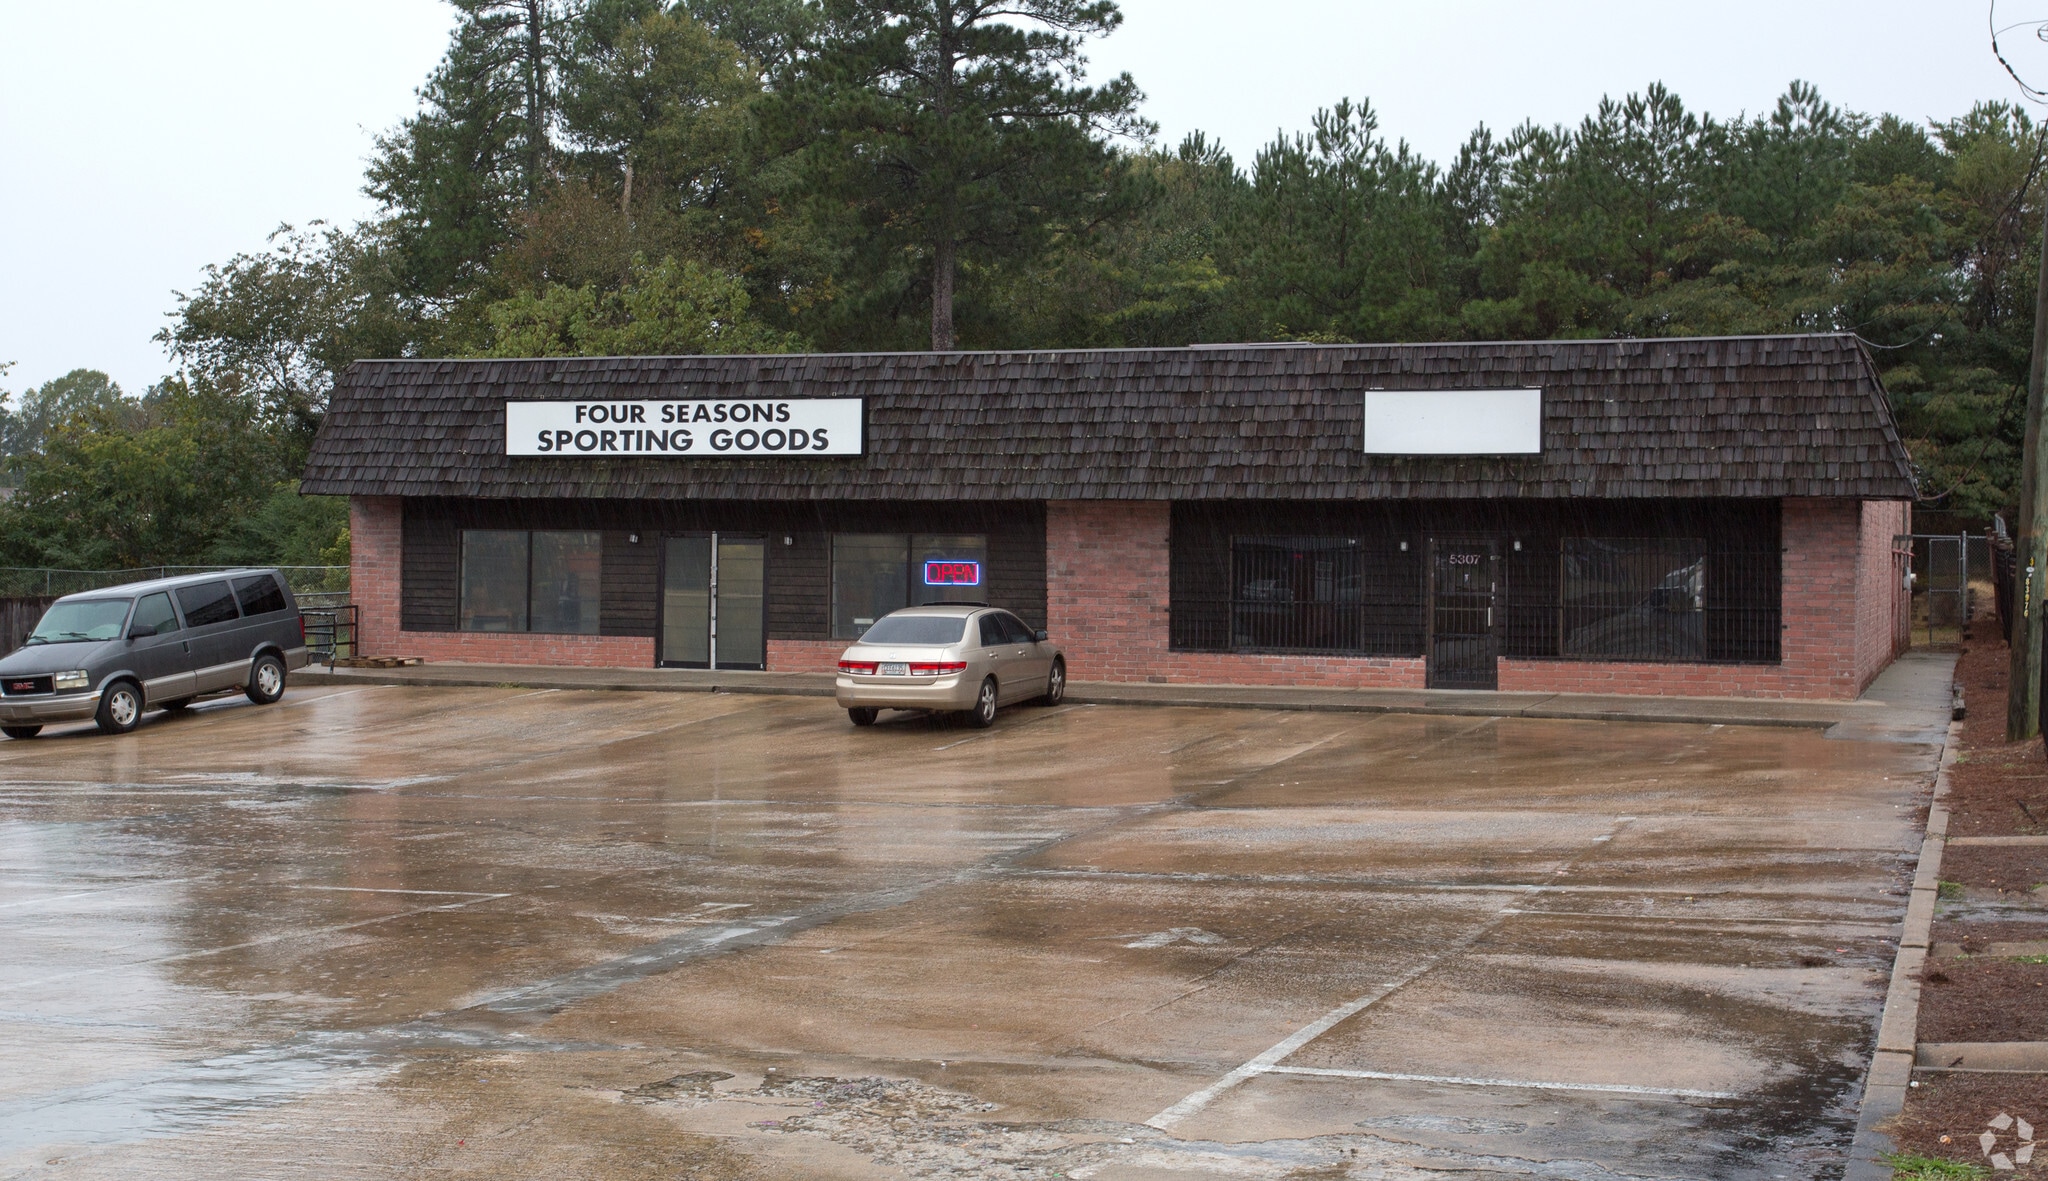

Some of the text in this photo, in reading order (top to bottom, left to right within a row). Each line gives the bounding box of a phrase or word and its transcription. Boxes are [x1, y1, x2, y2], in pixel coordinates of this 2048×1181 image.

[575, 403, 790, 424] FOUR SEASONS
[537, 428, 829, 452] SPORTING GOODS
[1449, 554, 1481, 565] 5307
[927, 563, 977, 583] OPEN
[12, 681, 35, 691] GMC
